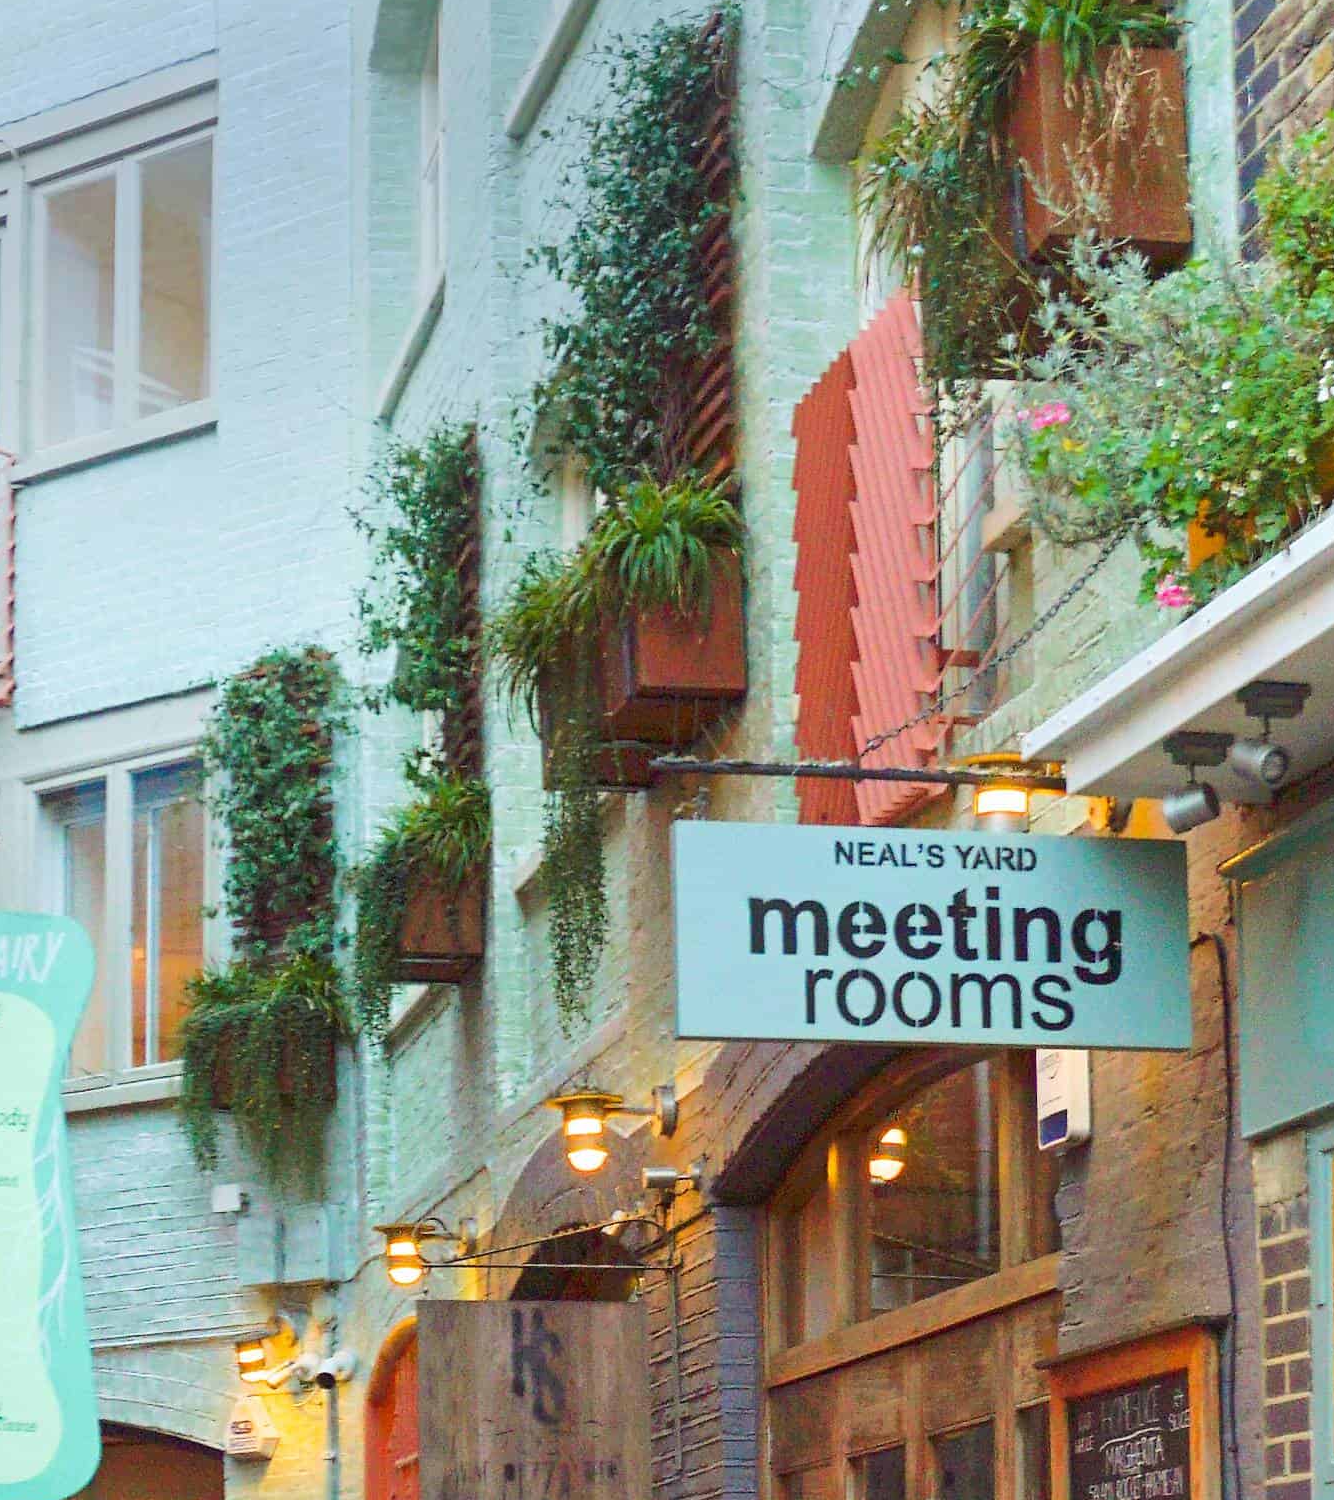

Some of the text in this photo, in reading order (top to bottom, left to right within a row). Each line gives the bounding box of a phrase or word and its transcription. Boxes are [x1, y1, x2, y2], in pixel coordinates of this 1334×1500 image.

[834, 841, 1038, 873] NEAL'S YARD
[748, 886, 1123, 986] meeting
[804, 968, 1076, 1032] rooms
